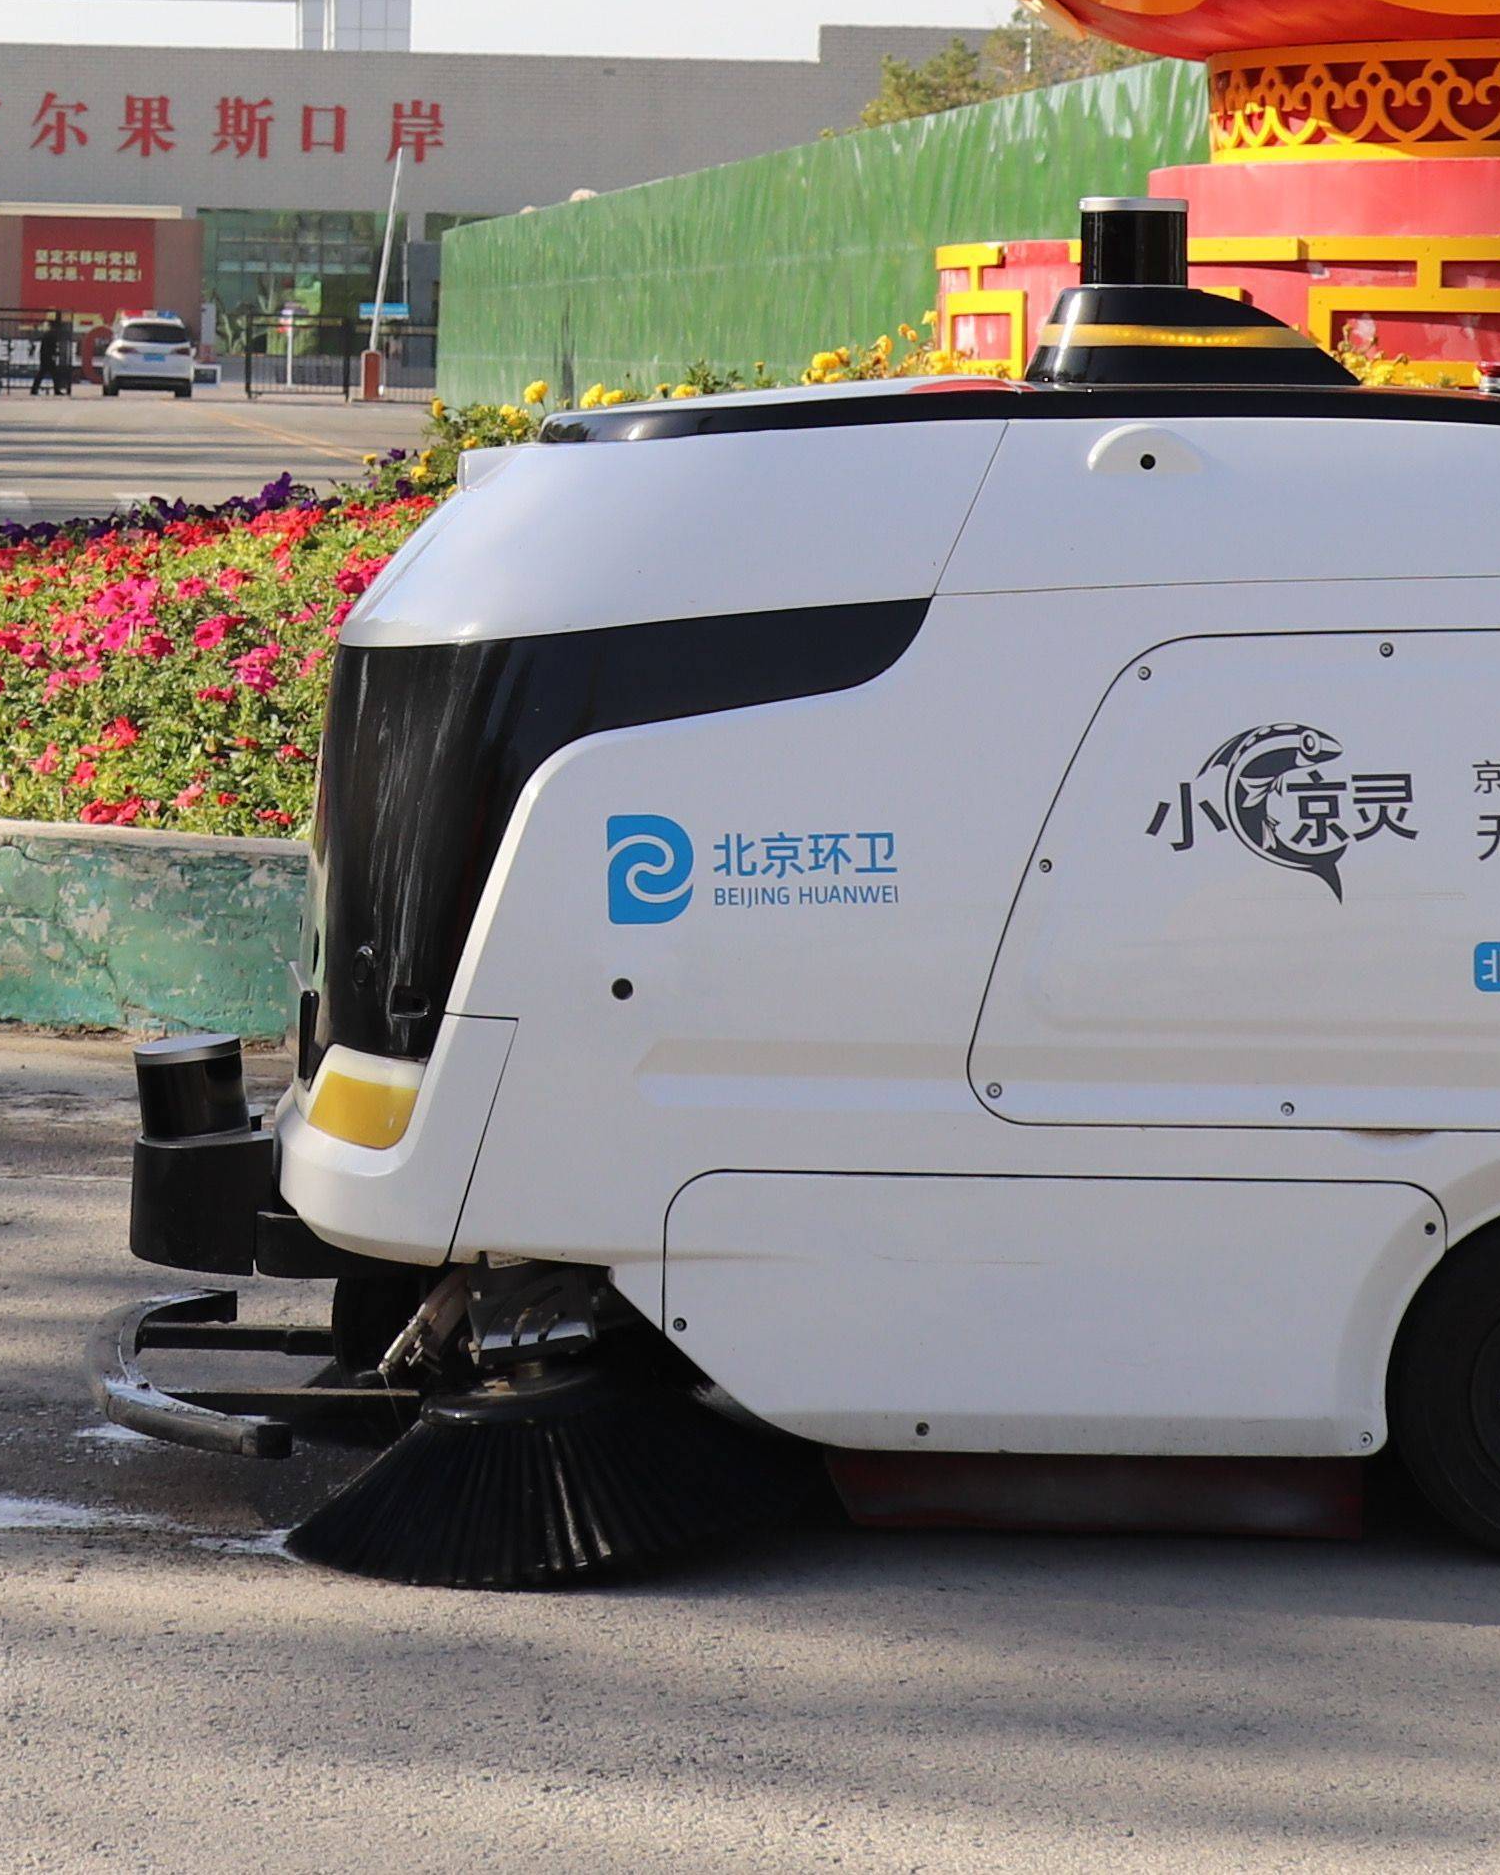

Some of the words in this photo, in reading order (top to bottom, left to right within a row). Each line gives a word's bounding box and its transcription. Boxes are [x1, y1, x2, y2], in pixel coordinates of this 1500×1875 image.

[712, 829, 899, 878] 北京环卫
[713, 885, 790, 910] BEIJING
[798, 884, 899, 907] HUANWEI
